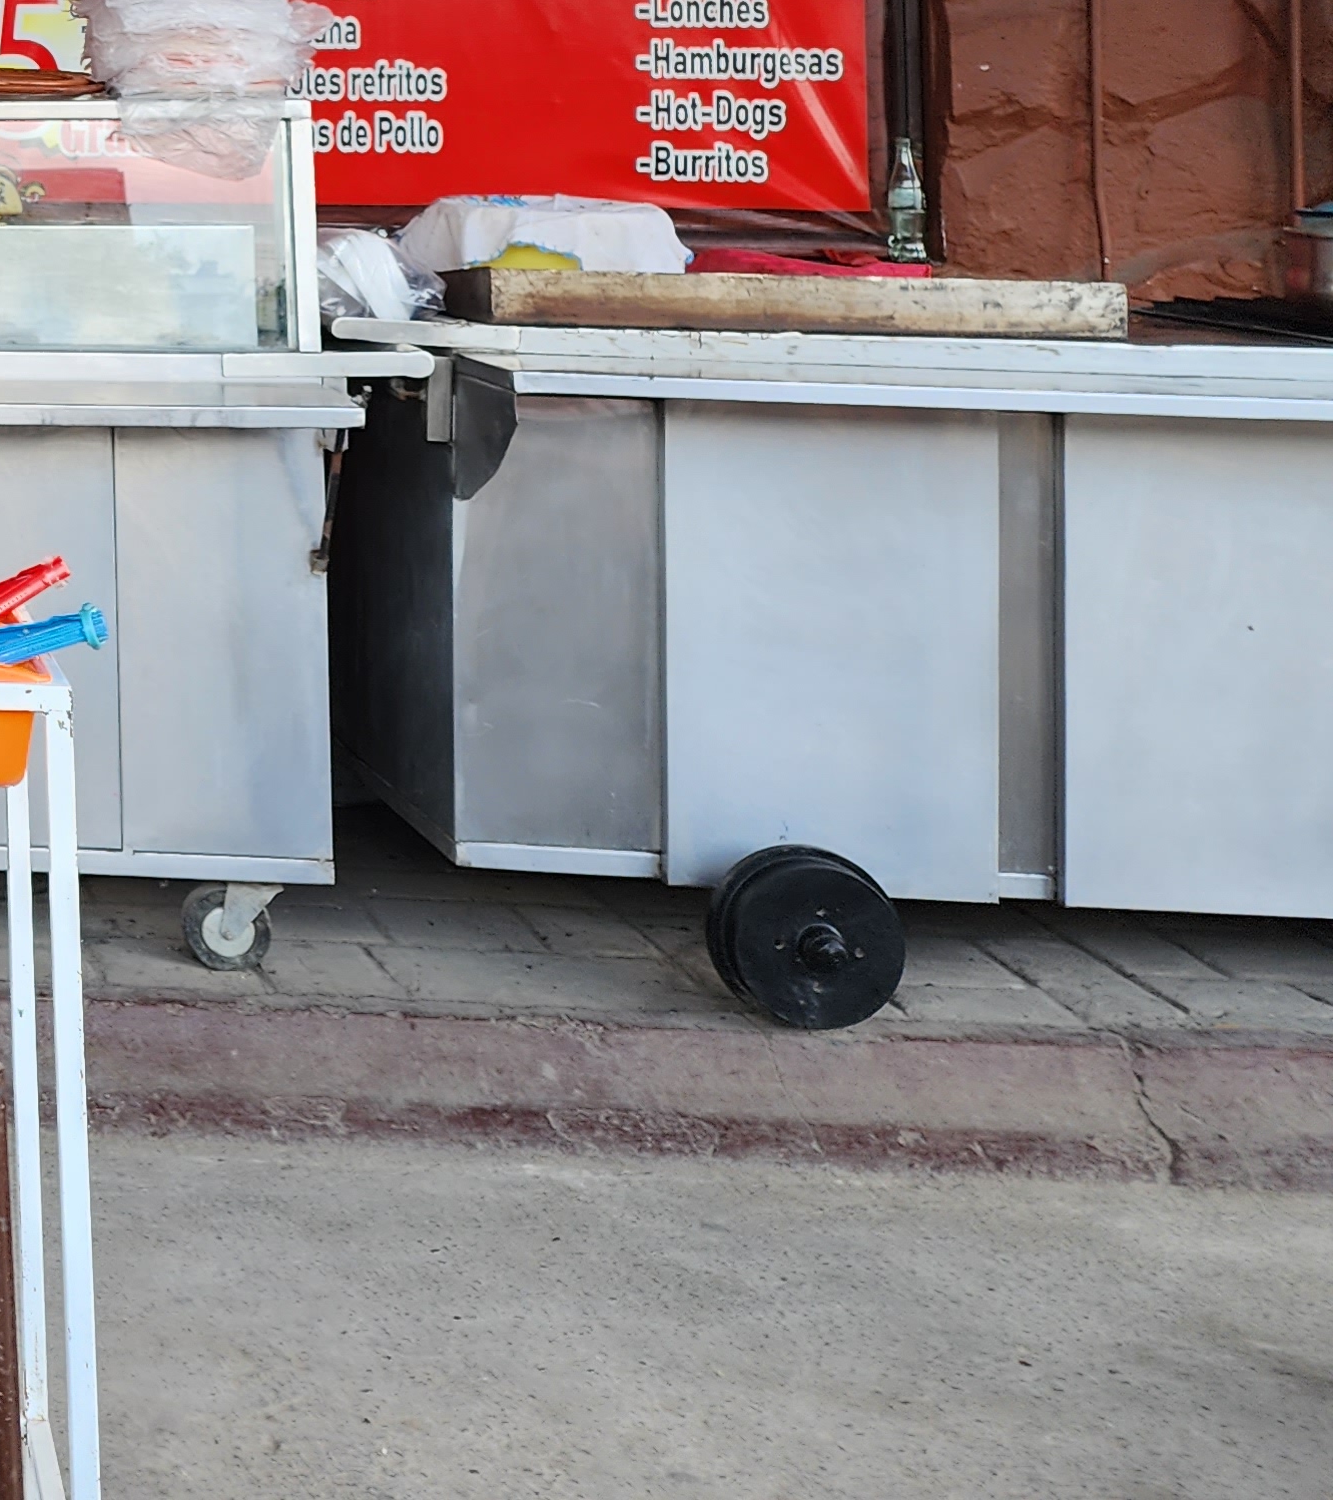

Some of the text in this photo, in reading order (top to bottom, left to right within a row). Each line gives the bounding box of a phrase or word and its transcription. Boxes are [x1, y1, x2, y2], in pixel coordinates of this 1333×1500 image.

[351, 64, 443, 96] refritos
[340, 116, 368, 147] de
[378, 116, 440, 147] Pollo
